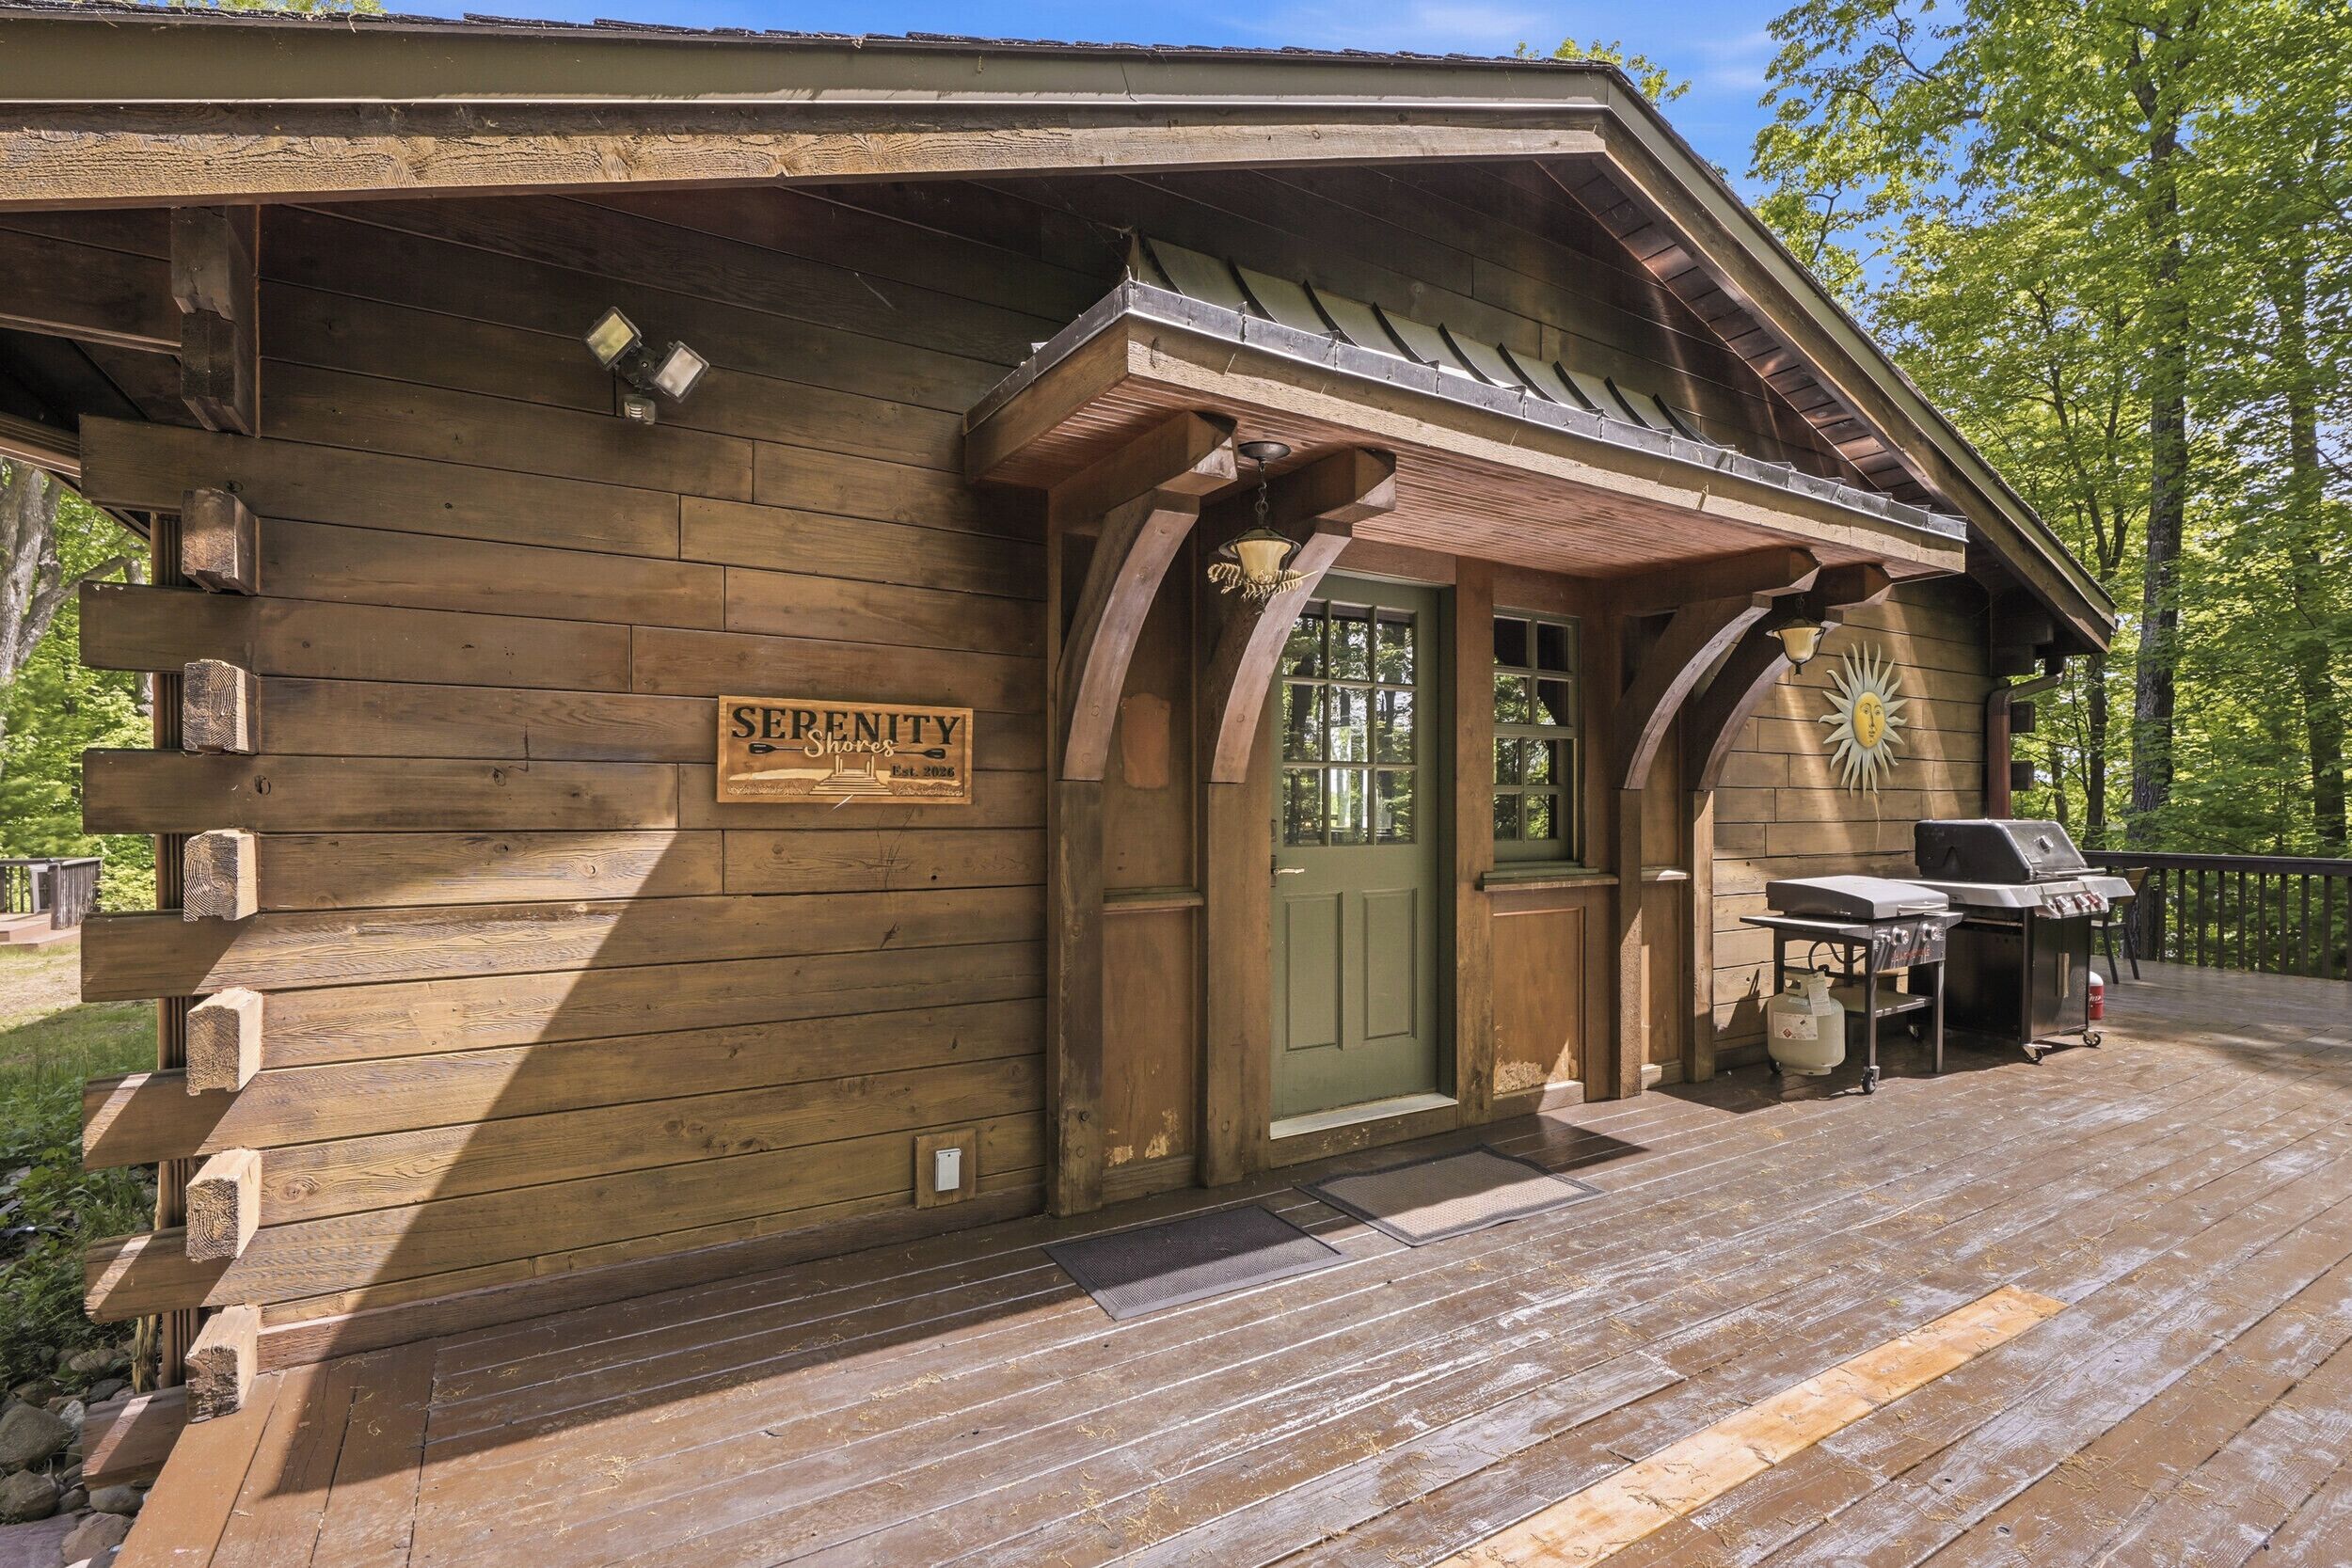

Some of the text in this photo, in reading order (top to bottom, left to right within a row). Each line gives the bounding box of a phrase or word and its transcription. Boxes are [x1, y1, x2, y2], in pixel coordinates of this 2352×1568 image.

[732, 706, 961, 745] SERENITY
[804, 728, 898, 758] Shores
[892, 765, 918, 777] Est.
